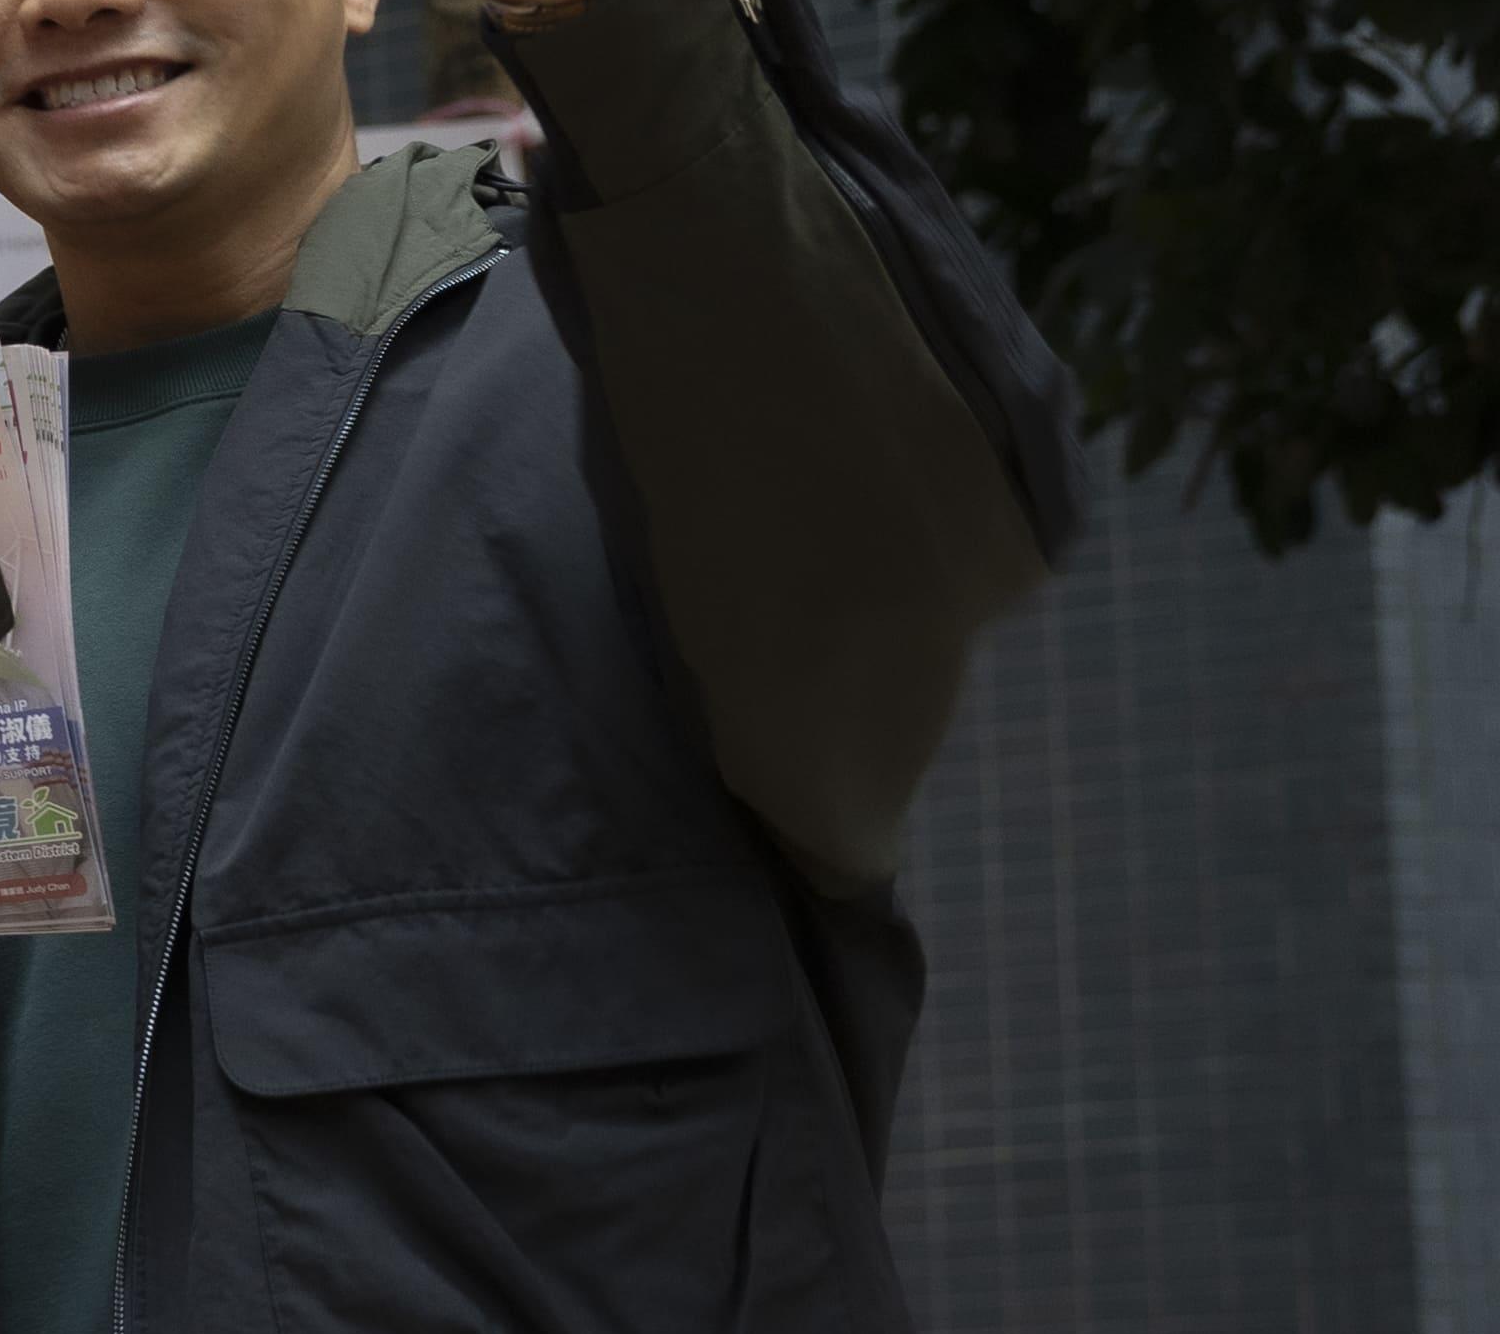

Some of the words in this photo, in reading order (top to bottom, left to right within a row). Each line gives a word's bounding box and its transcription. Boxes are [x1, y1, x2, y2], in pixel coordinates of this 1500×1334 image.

[14, 699, 28, 713] IP
[3, 766, 53, 781] SUPPORT
[32, 841, 81, 858] District
[26, 884, 47, 895] Judy
[47, 882, 71, 892] Chan
